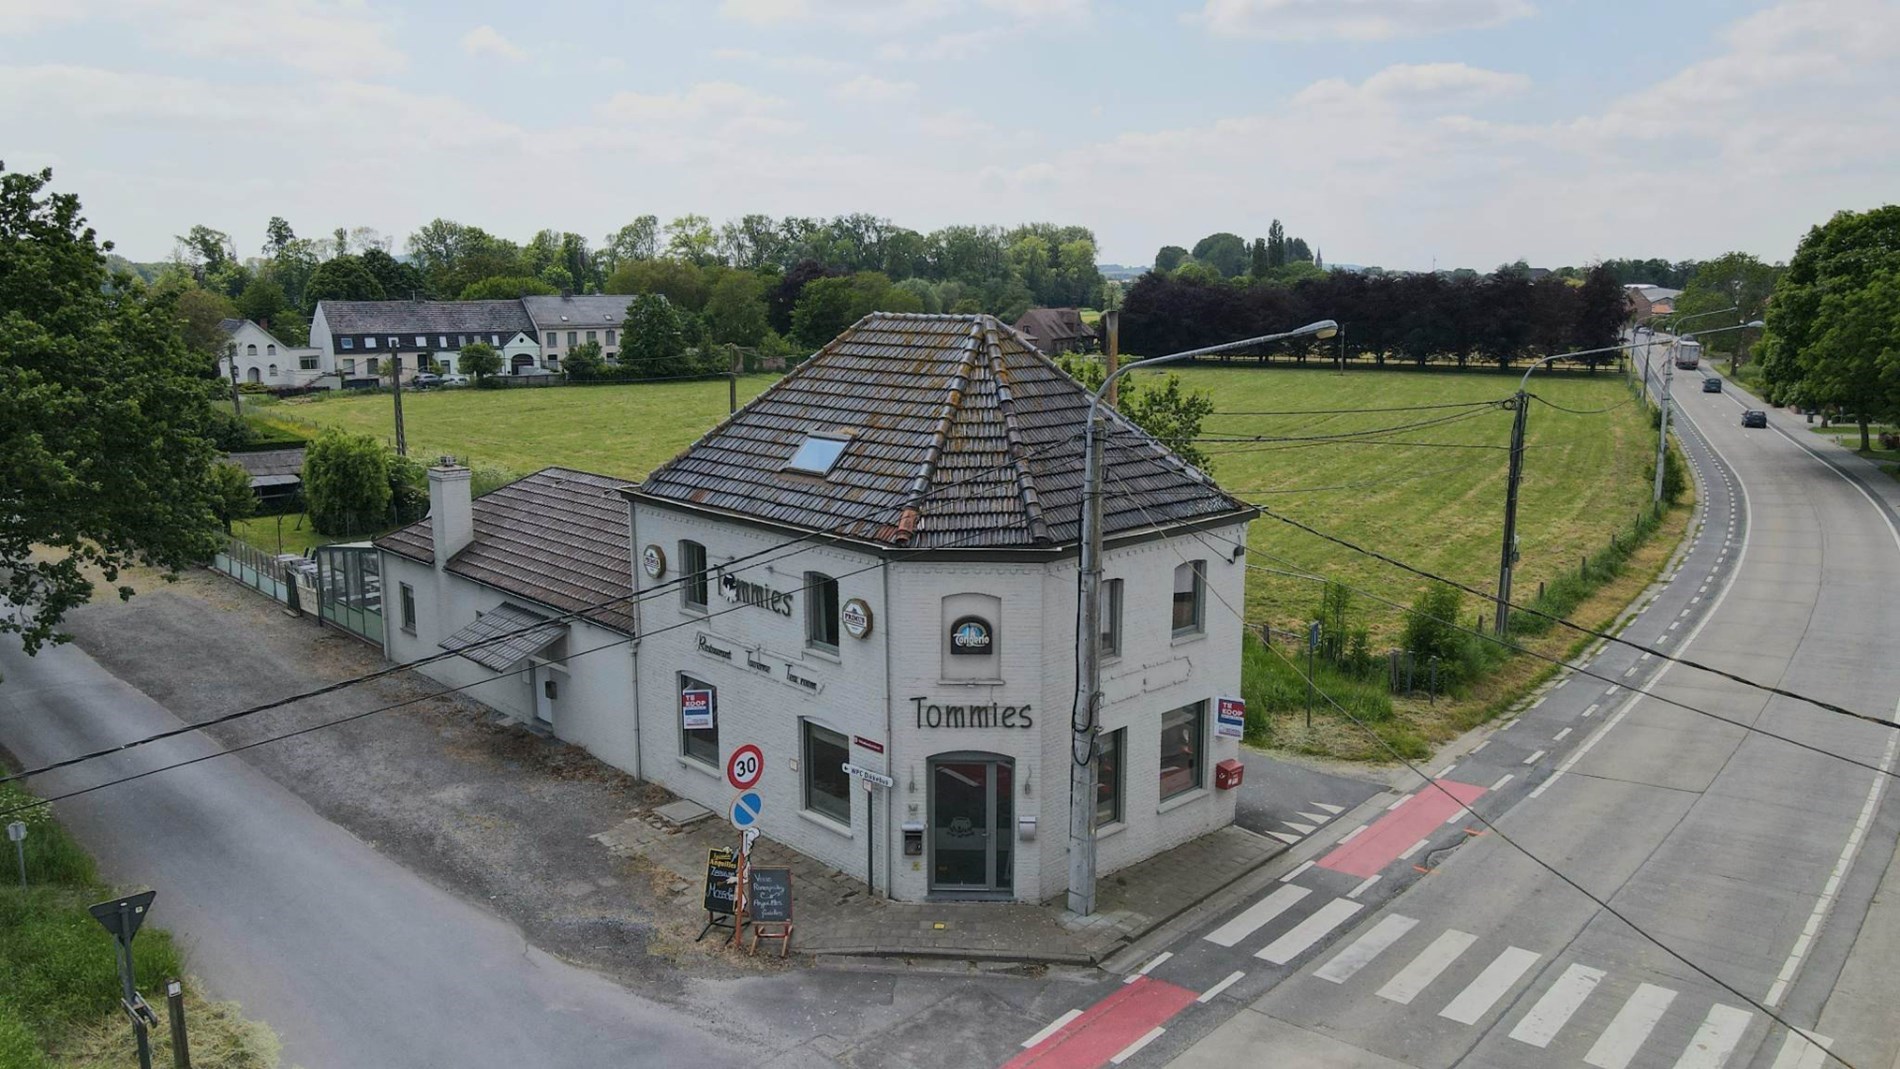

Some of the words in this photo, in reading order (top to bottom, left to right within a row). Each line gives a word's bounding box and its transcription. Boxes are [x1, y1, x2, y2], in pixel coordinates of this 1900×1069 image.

[713, 564, 794, 617] Tmmies
[909, 697, 1033, 730] Tommies
[1222, 708, 1243, 717] KOOP
[736, 756, 756, 778] 30
